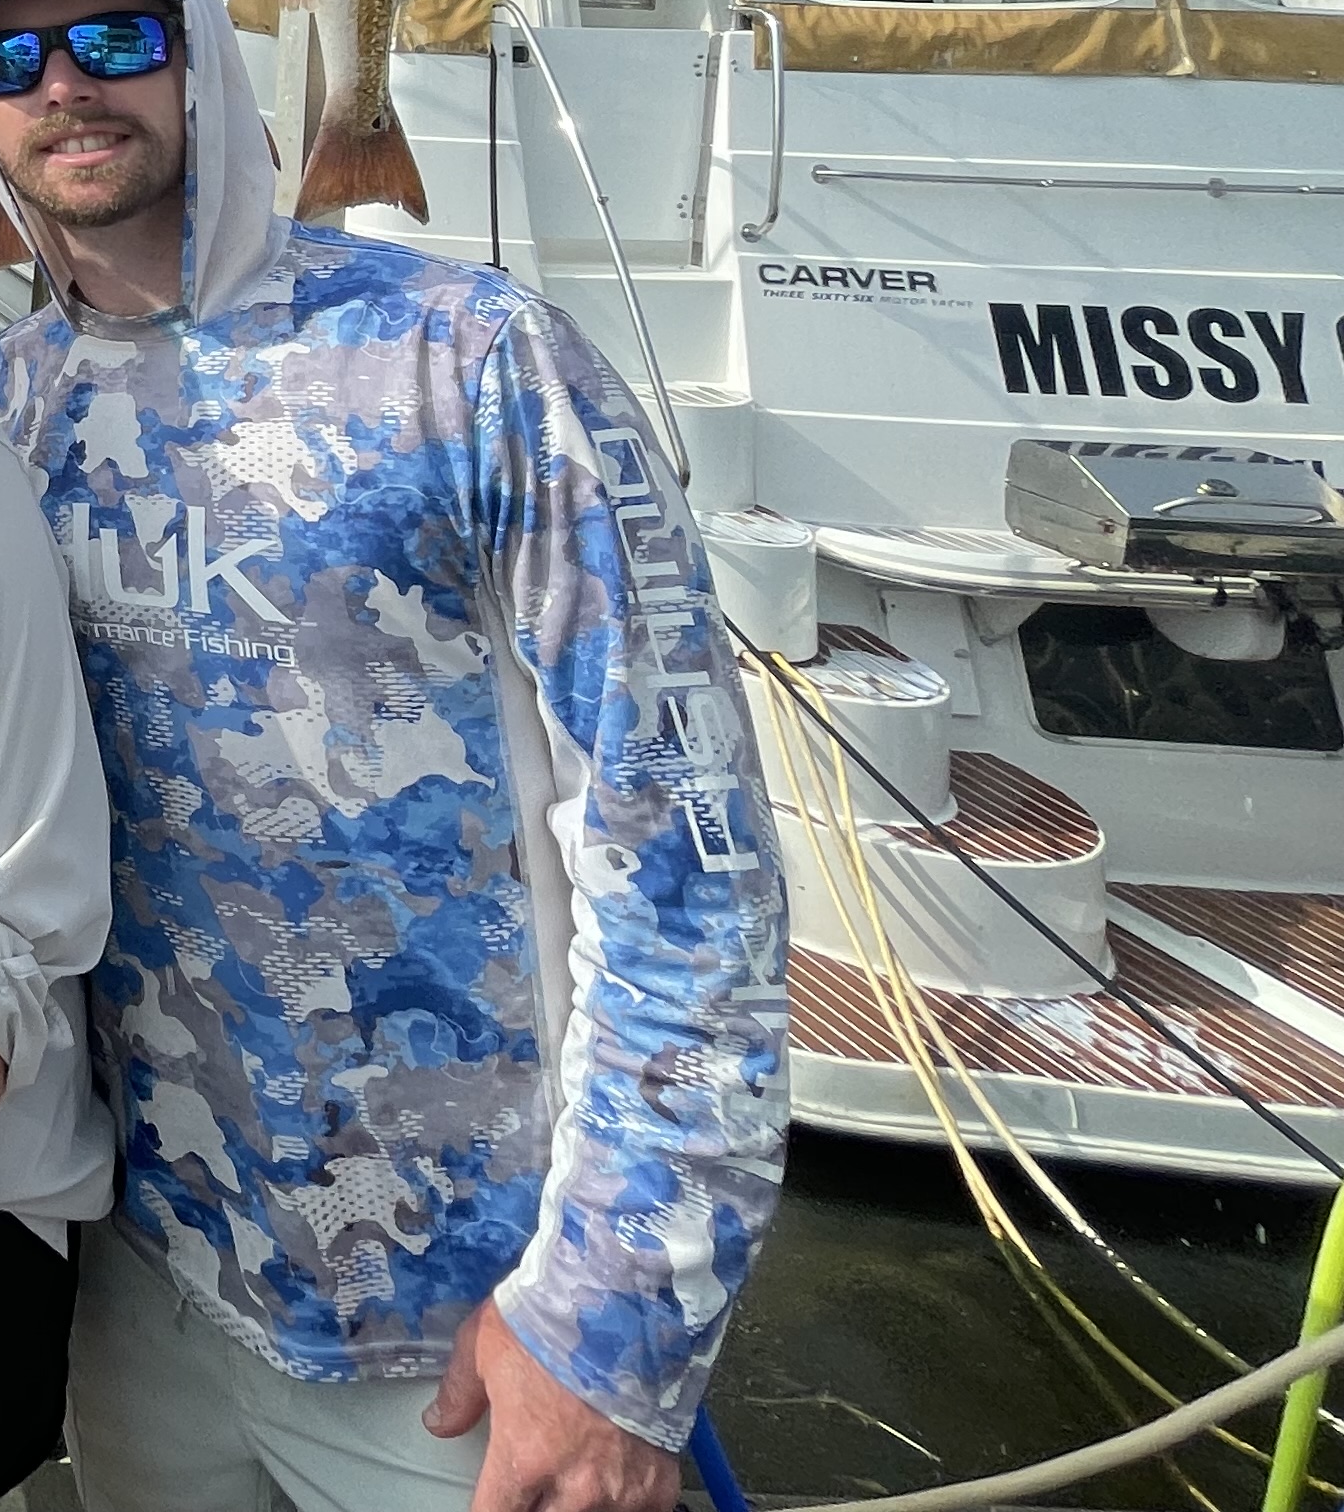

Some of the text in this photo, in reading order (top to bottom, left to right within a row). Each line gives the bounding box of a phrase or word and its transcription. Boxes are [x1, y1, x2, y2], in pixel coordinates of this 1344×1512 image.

[758, 263, 938, 293] CARVER
[762, 288, 805, 300] THREE
[811, 291, 850, 302] SIXTY
[852, 292, 874, 303] SIX
[988, 302, 1310, 405] MISSY
[184, 630, 297, 668] Fishing
